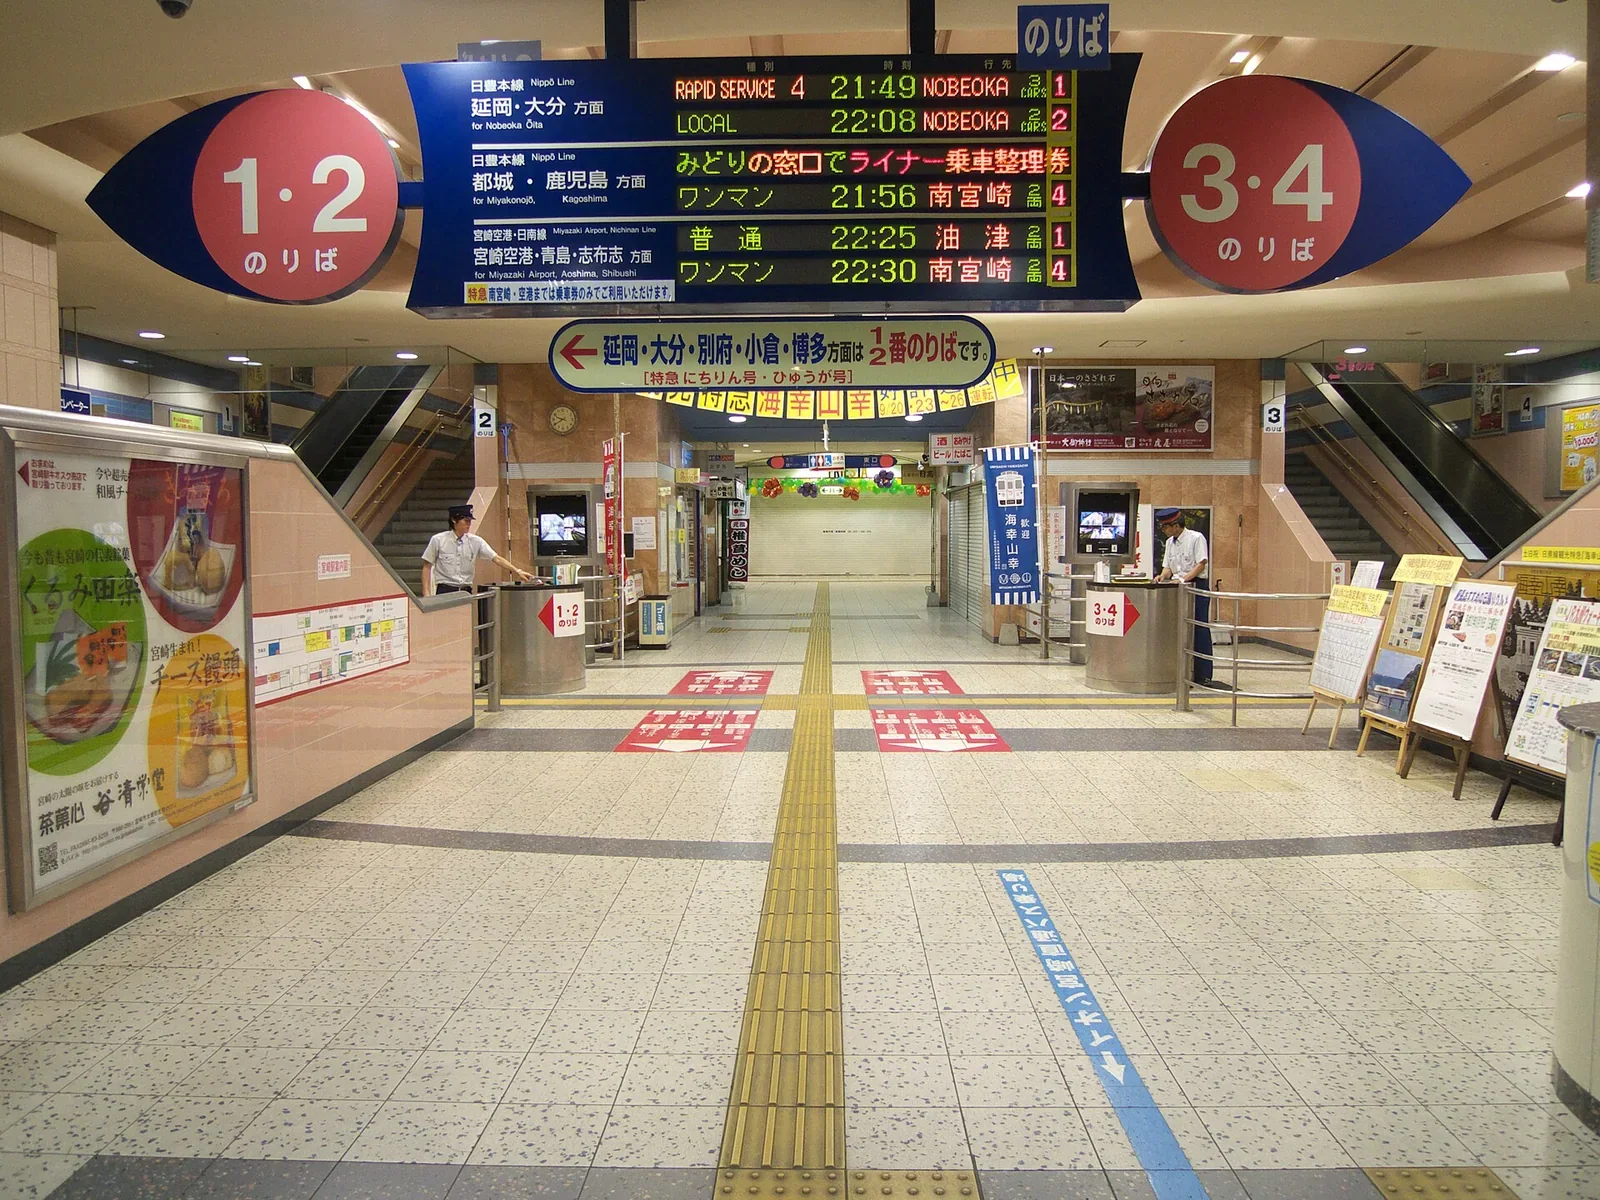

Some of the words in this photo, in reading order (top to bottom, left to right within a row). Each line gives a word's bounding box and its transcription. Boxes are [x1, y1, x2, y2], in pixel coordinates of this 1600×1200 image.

[1024, 12, 1105, 58] のりば
[746, 61, 775, 72] 種別
[883, 60, 912, 71] 時刻
[984, 59, 1012, 70] 行先
[471, 79, 525, 93] 日豊本線
[557, 77, 575, 86] Line
[720, 79, 776, 98] SERVICE
[791, 77, 806, 99] 4
[830, 75, 917, 99] 21:49
[922, 77, 1010, 98] NOBEOKA
[1029, 74, 1041, 87] 3
[1055, 75, 1066, 97] 1
[675, 81, 716, 99] RAPID
[1020, 87, 1047, 98] CARS
[471, 96, 566, 117] 延岡・大分
[573, 100, 604, 115] 方面
[1029, 108, 1041, 121] 2
[472, 121, 483, 130] for
[486, 121, 522, 130] Nobeoka
[677, 114, 737, 134] LOCAL
[830, 109, 917, 133] 22:08
[922, 111, 1010, 132] NOBEOKA
[1020, 121, 1047, 132] CARS
[1052, 109, 1068, 131] 2
[472, 153, 526, 167] 日豊本線
[558, 152, 576, 161] Line
[676, 146, 1071, 176] みどりの窓口でライナー乗車整理券
[616, 174, 646, 189] 方面
[473, 196, 484, 205] for
[562, 195, 608, 205] Kagoshima
[678, 186, 775, 209] ワンマン
[830, 184, 917, 209] 21:56
[928, 182, 1012, 209] 南宮崎
[1052, 183, 1067, 206] 4
[473, 229, 547, 242] 宮崎空港・日南線
[553, 227, 582, 236] Miyazaki
[610, 226, 640, 234] Nichinan
[689, 225, 764, 251] 普通
[830, 225, 917, 250] 22:25
[935, 224, 1011, 251] 油津
[1054, 226, 1066, 248] 1
[473, 245, 624, 266] 宮崎空港・青島・志布志
[630, 249, 653, 264] 方面
[1218, 237, 1315, 262] のりば
[243, 247, 339, 275] のりば
[474, 271, 486, 279] for
[489, 271, 525, 280] Miyazaki
[528, 270, 558, 279] Airport,
[561, 270, 599, 278] Aoshima,
[602, 269, 637, 278] Shibushi
[678, 262, 775, 284] ワンマン
[830, 259, 917, 284] 22:30
[928, 257, 1012, 284] 南宮崎
[1052, 260, 1067, 281] 4
[467, 287, 487, 301] 特急
[969, 389, 995, 404] 運転
[1523, 396, 1531, 412] 4
[479, 412, 492, 428] 2
[1268, 407, 1281, 424] 3
[936, 436, 948, 446] 酒
[953, 435, 972, 445] おみやげ
[933, 449, 952, 459] ビール
[953, 449, 972, 459] たばこ
[1020, 518, 1031, 540] 歓迎
[1004, 514, 1020, 570] 海幸山幸
[558, 617, 578, 628] のりば
[1095, 617, 1116, 627] のりば
[150, 648, 241, 698] チーズ饅頭
[38, 801, 87, 838] 茶菓心
[1001, 871, 1115, 1048] イオン宮崎直通バス乗り場
